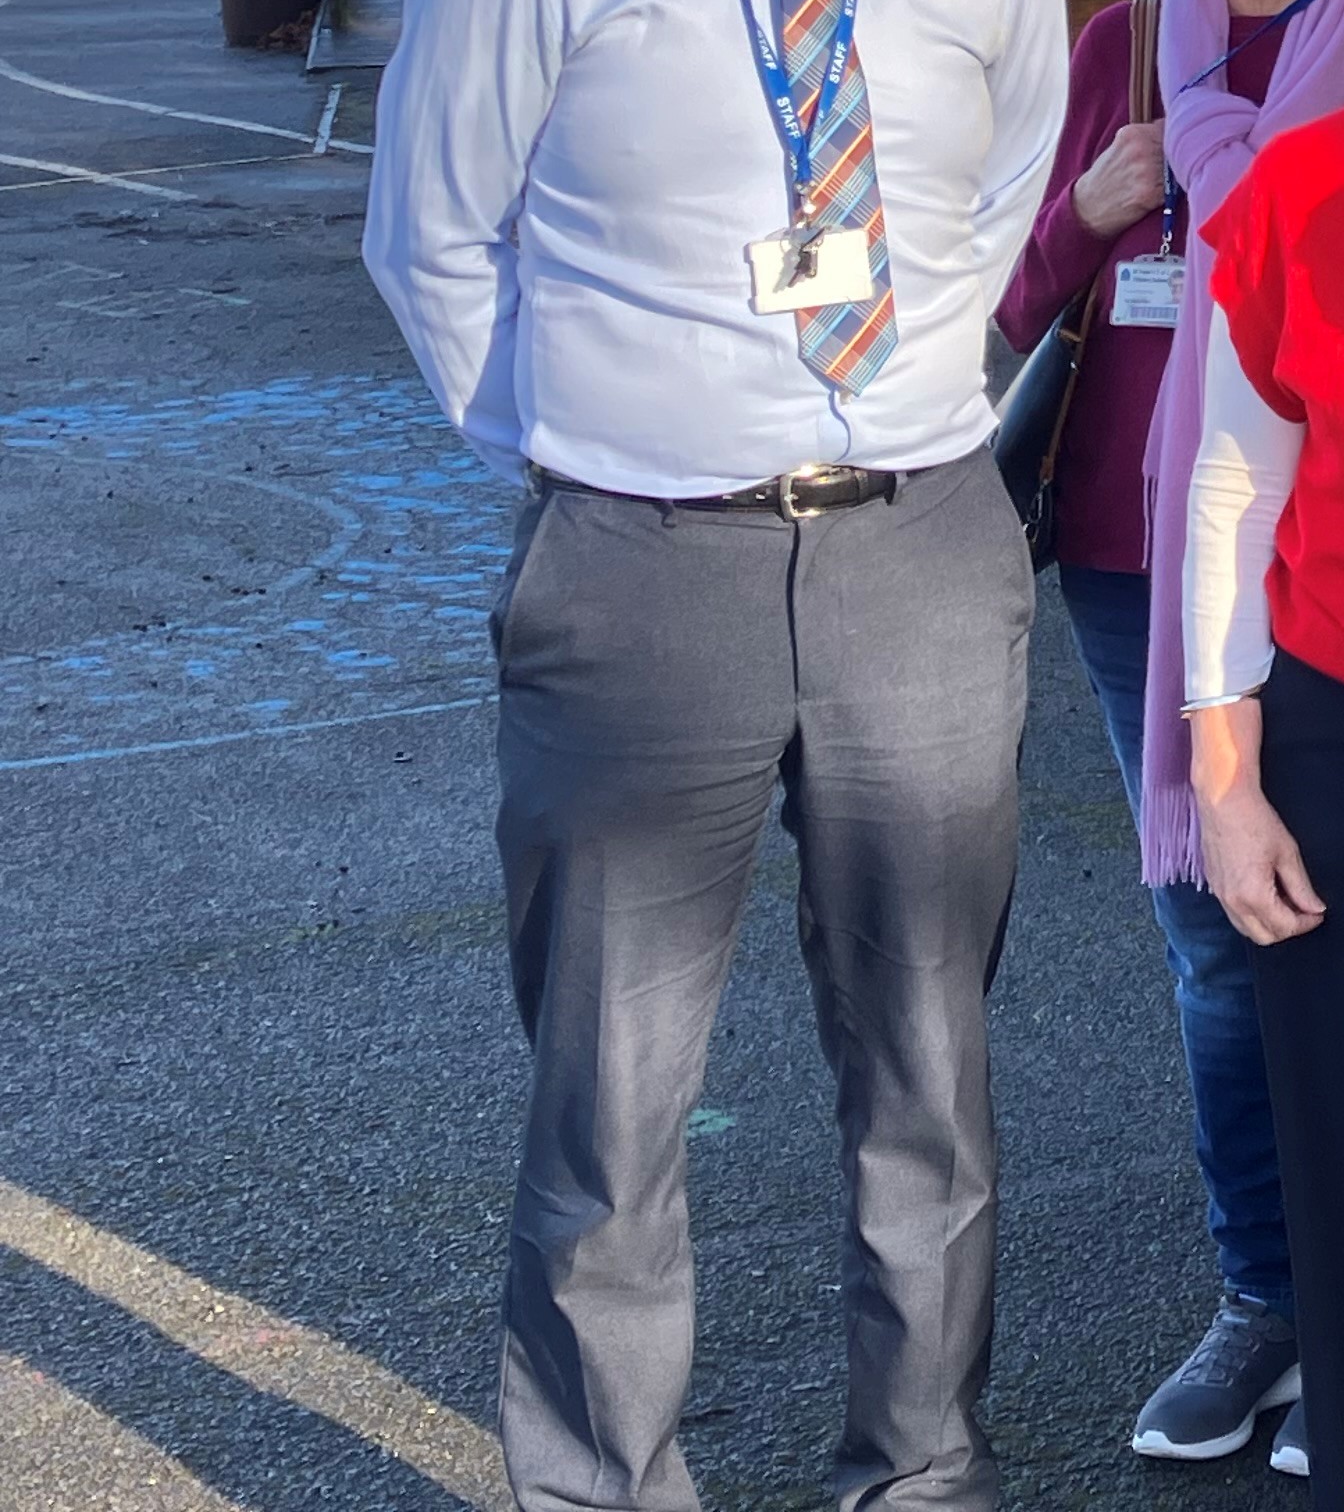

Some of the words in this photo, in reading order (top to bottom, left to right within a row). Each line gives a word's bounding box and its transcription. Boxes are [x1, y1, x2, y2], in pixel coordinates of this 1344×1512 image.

[757, 29, 778, 71] STAFF
[829, 41, 848, 84] STAFF
[776, 96, 802, 139] STAFF
